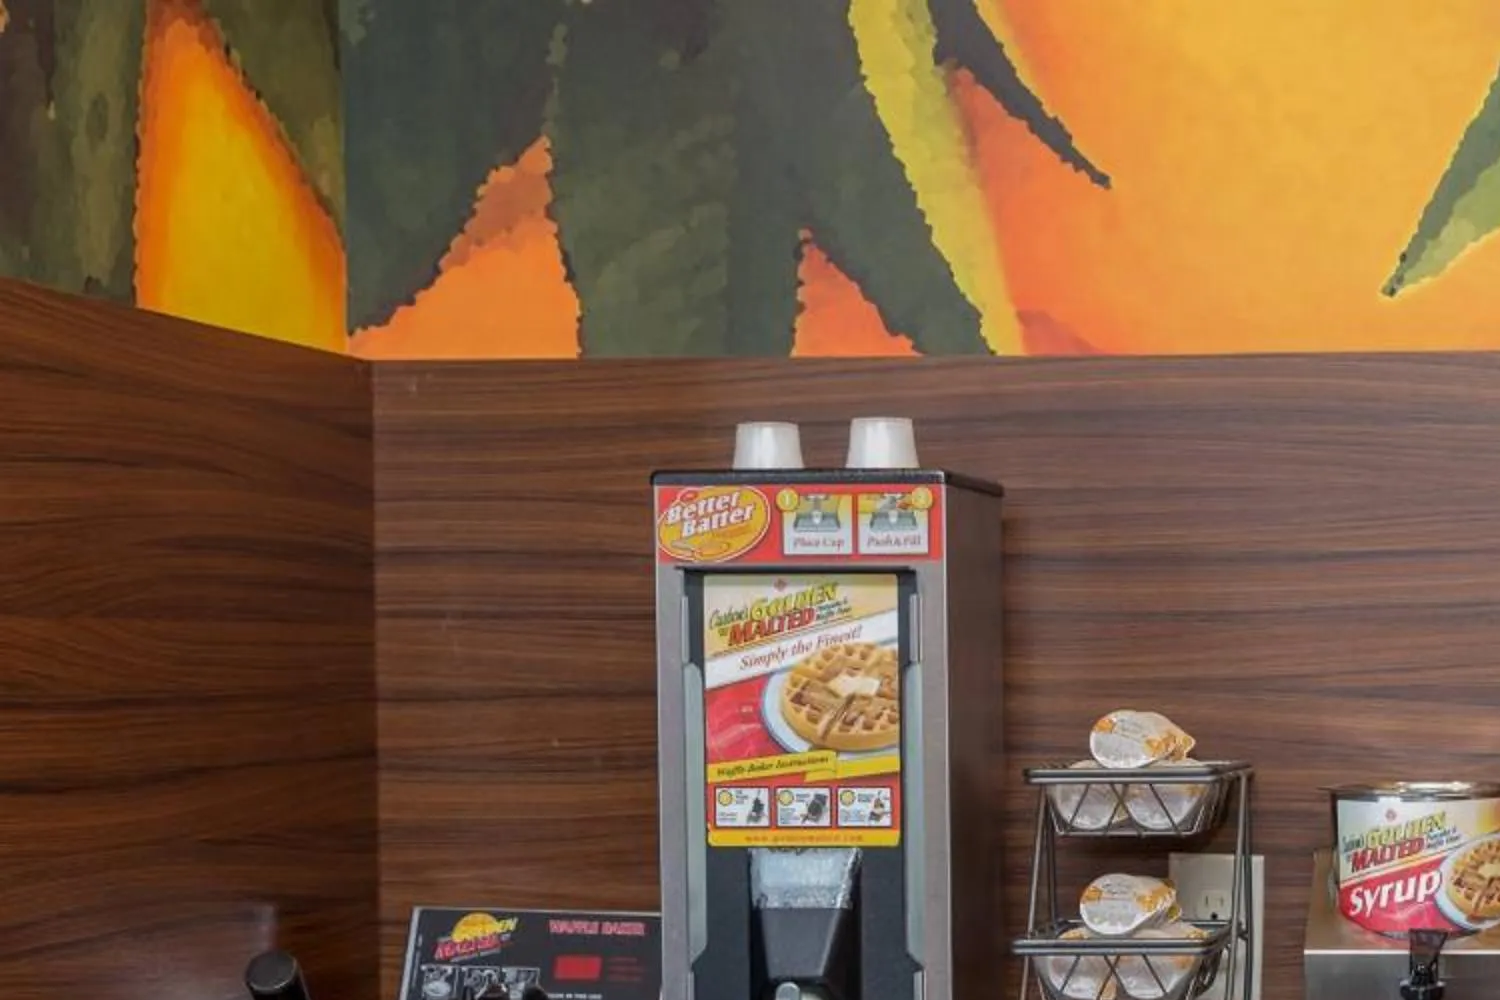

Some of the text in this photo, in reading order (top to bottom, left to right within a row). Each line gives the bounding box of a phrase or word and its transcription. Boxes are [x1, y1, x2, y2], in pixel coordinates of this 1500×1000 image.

[666, 490, 739, 524] Better
[682, 503, 755, 538] Batter
[728, 606, 816, 646] MALTED
[740, 646, 788, 670] Simply
[791, 639, 813, 655] the
[1351, 835, 1426, 873] MALTED
[549, 919, 646, 936] WAFFLE BAKER
